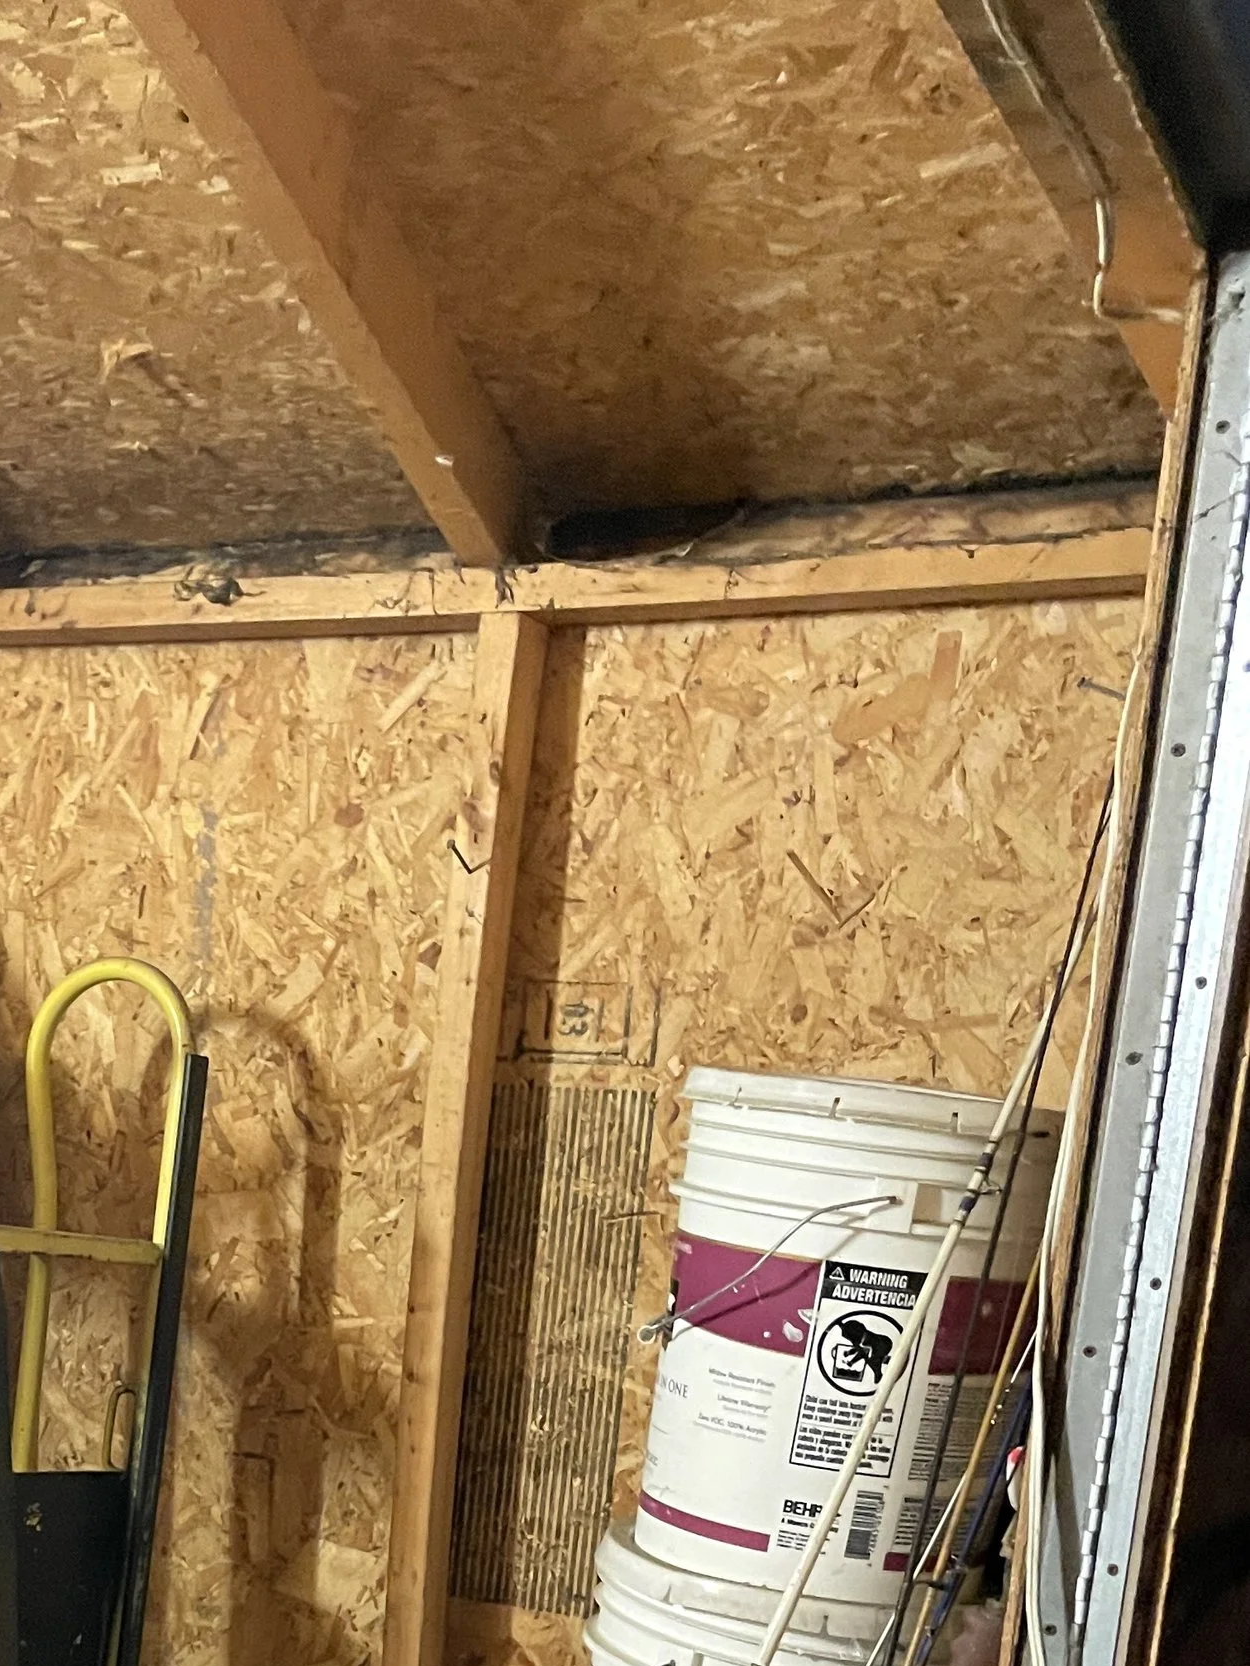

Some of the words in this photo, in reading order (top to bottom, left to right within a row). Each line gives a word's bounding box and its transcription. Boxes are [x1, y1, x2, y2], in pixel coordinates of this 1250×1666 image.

[850, 1268, 908, 1289] WARNING
[832, 1283, 916, 1307] ADVERTENCIA
[669, 1378, 689, 1399] ONE
